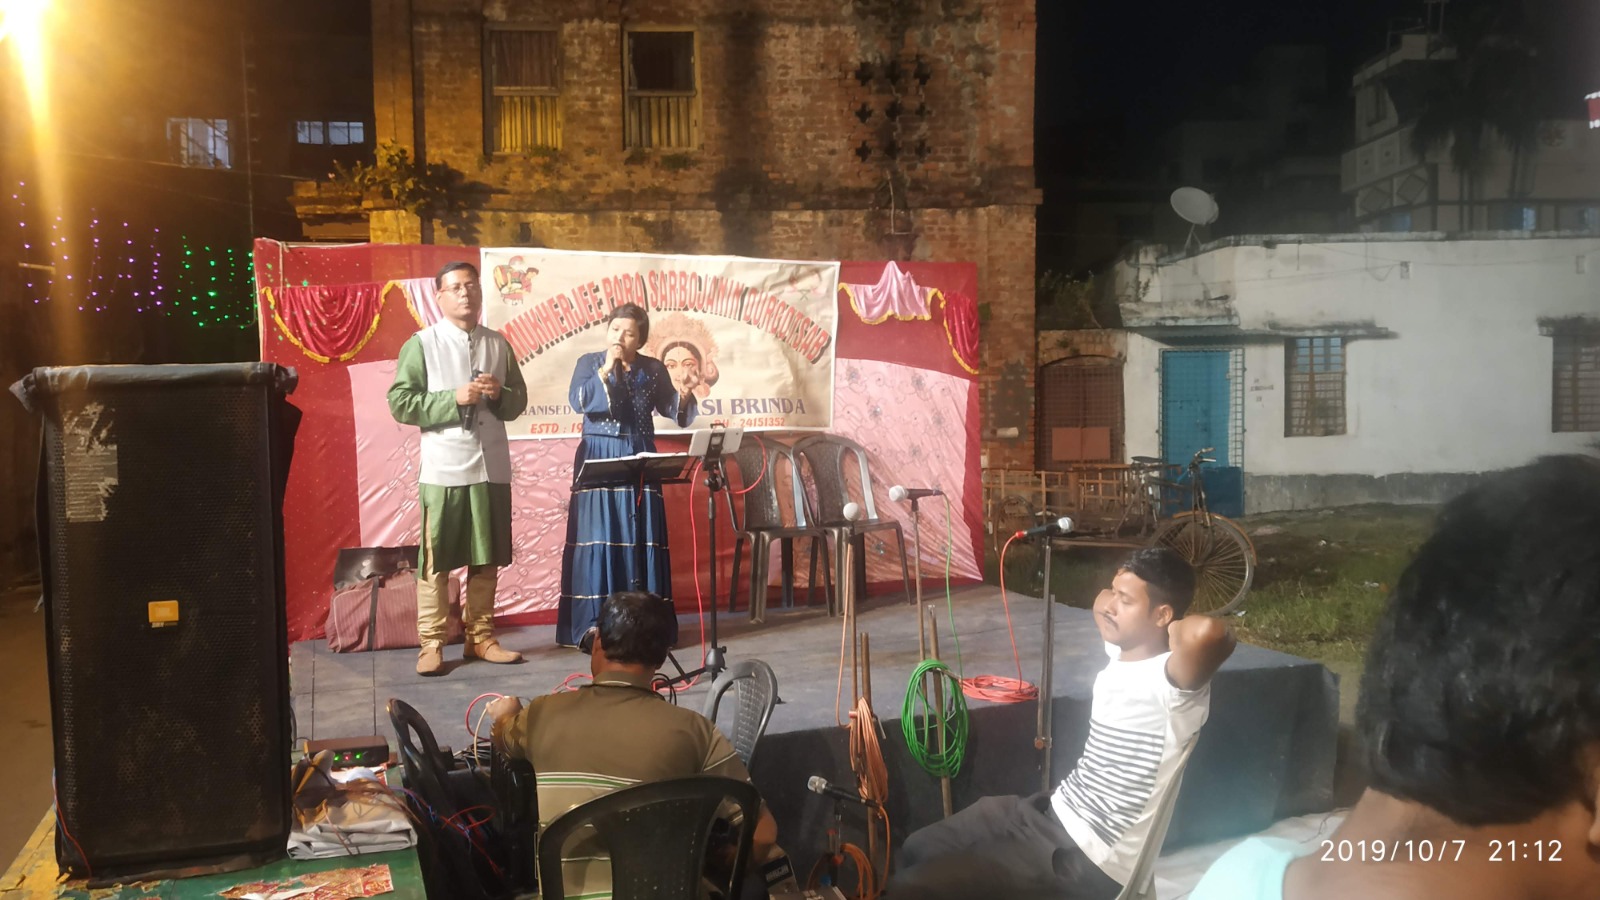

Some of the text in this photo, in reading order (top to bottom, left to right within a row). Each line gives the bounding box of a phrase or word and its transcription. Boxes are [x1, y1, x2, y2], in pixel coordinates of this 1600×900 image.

[498, 269, 831, 364] MUKHERJEE PARA SARBOJANIN DURGOTSAB
[730, 398, 806, 415] BRINDA
[530, 423, 559, 434] ESTD
[740, 417, 785, 428] 24151352
